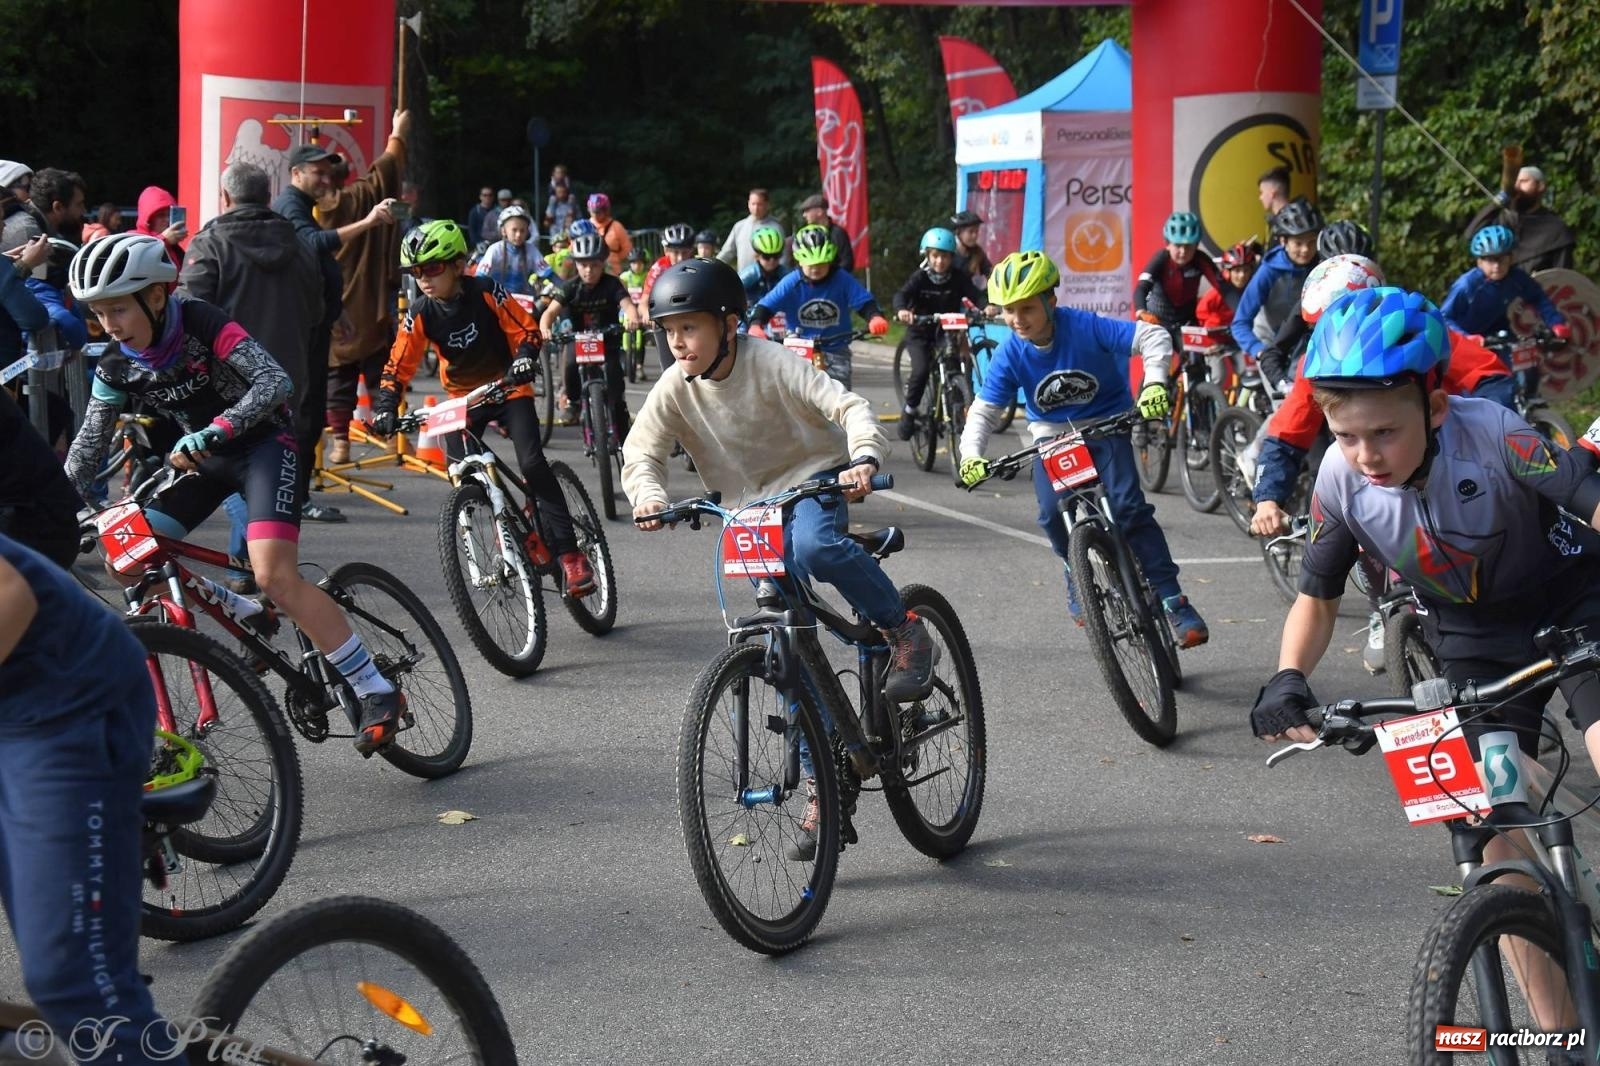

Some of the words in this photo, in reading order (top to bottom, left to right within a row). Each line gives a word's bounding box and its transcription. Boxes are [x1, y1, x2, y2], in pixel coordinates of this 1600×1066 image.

[1369, 0, 1395, 43] P
[275, 449, 297, 514] FENIKS
[1058, 453, 1078, 471] 61
[113, 523, 136, 546] 91
[736, 532, 770, 552] 64
[1406, 751, 1457, 786] 59
[87, 800, 104, 883] TOMMY
[88, 917, 120, 1009] HILFIGER
